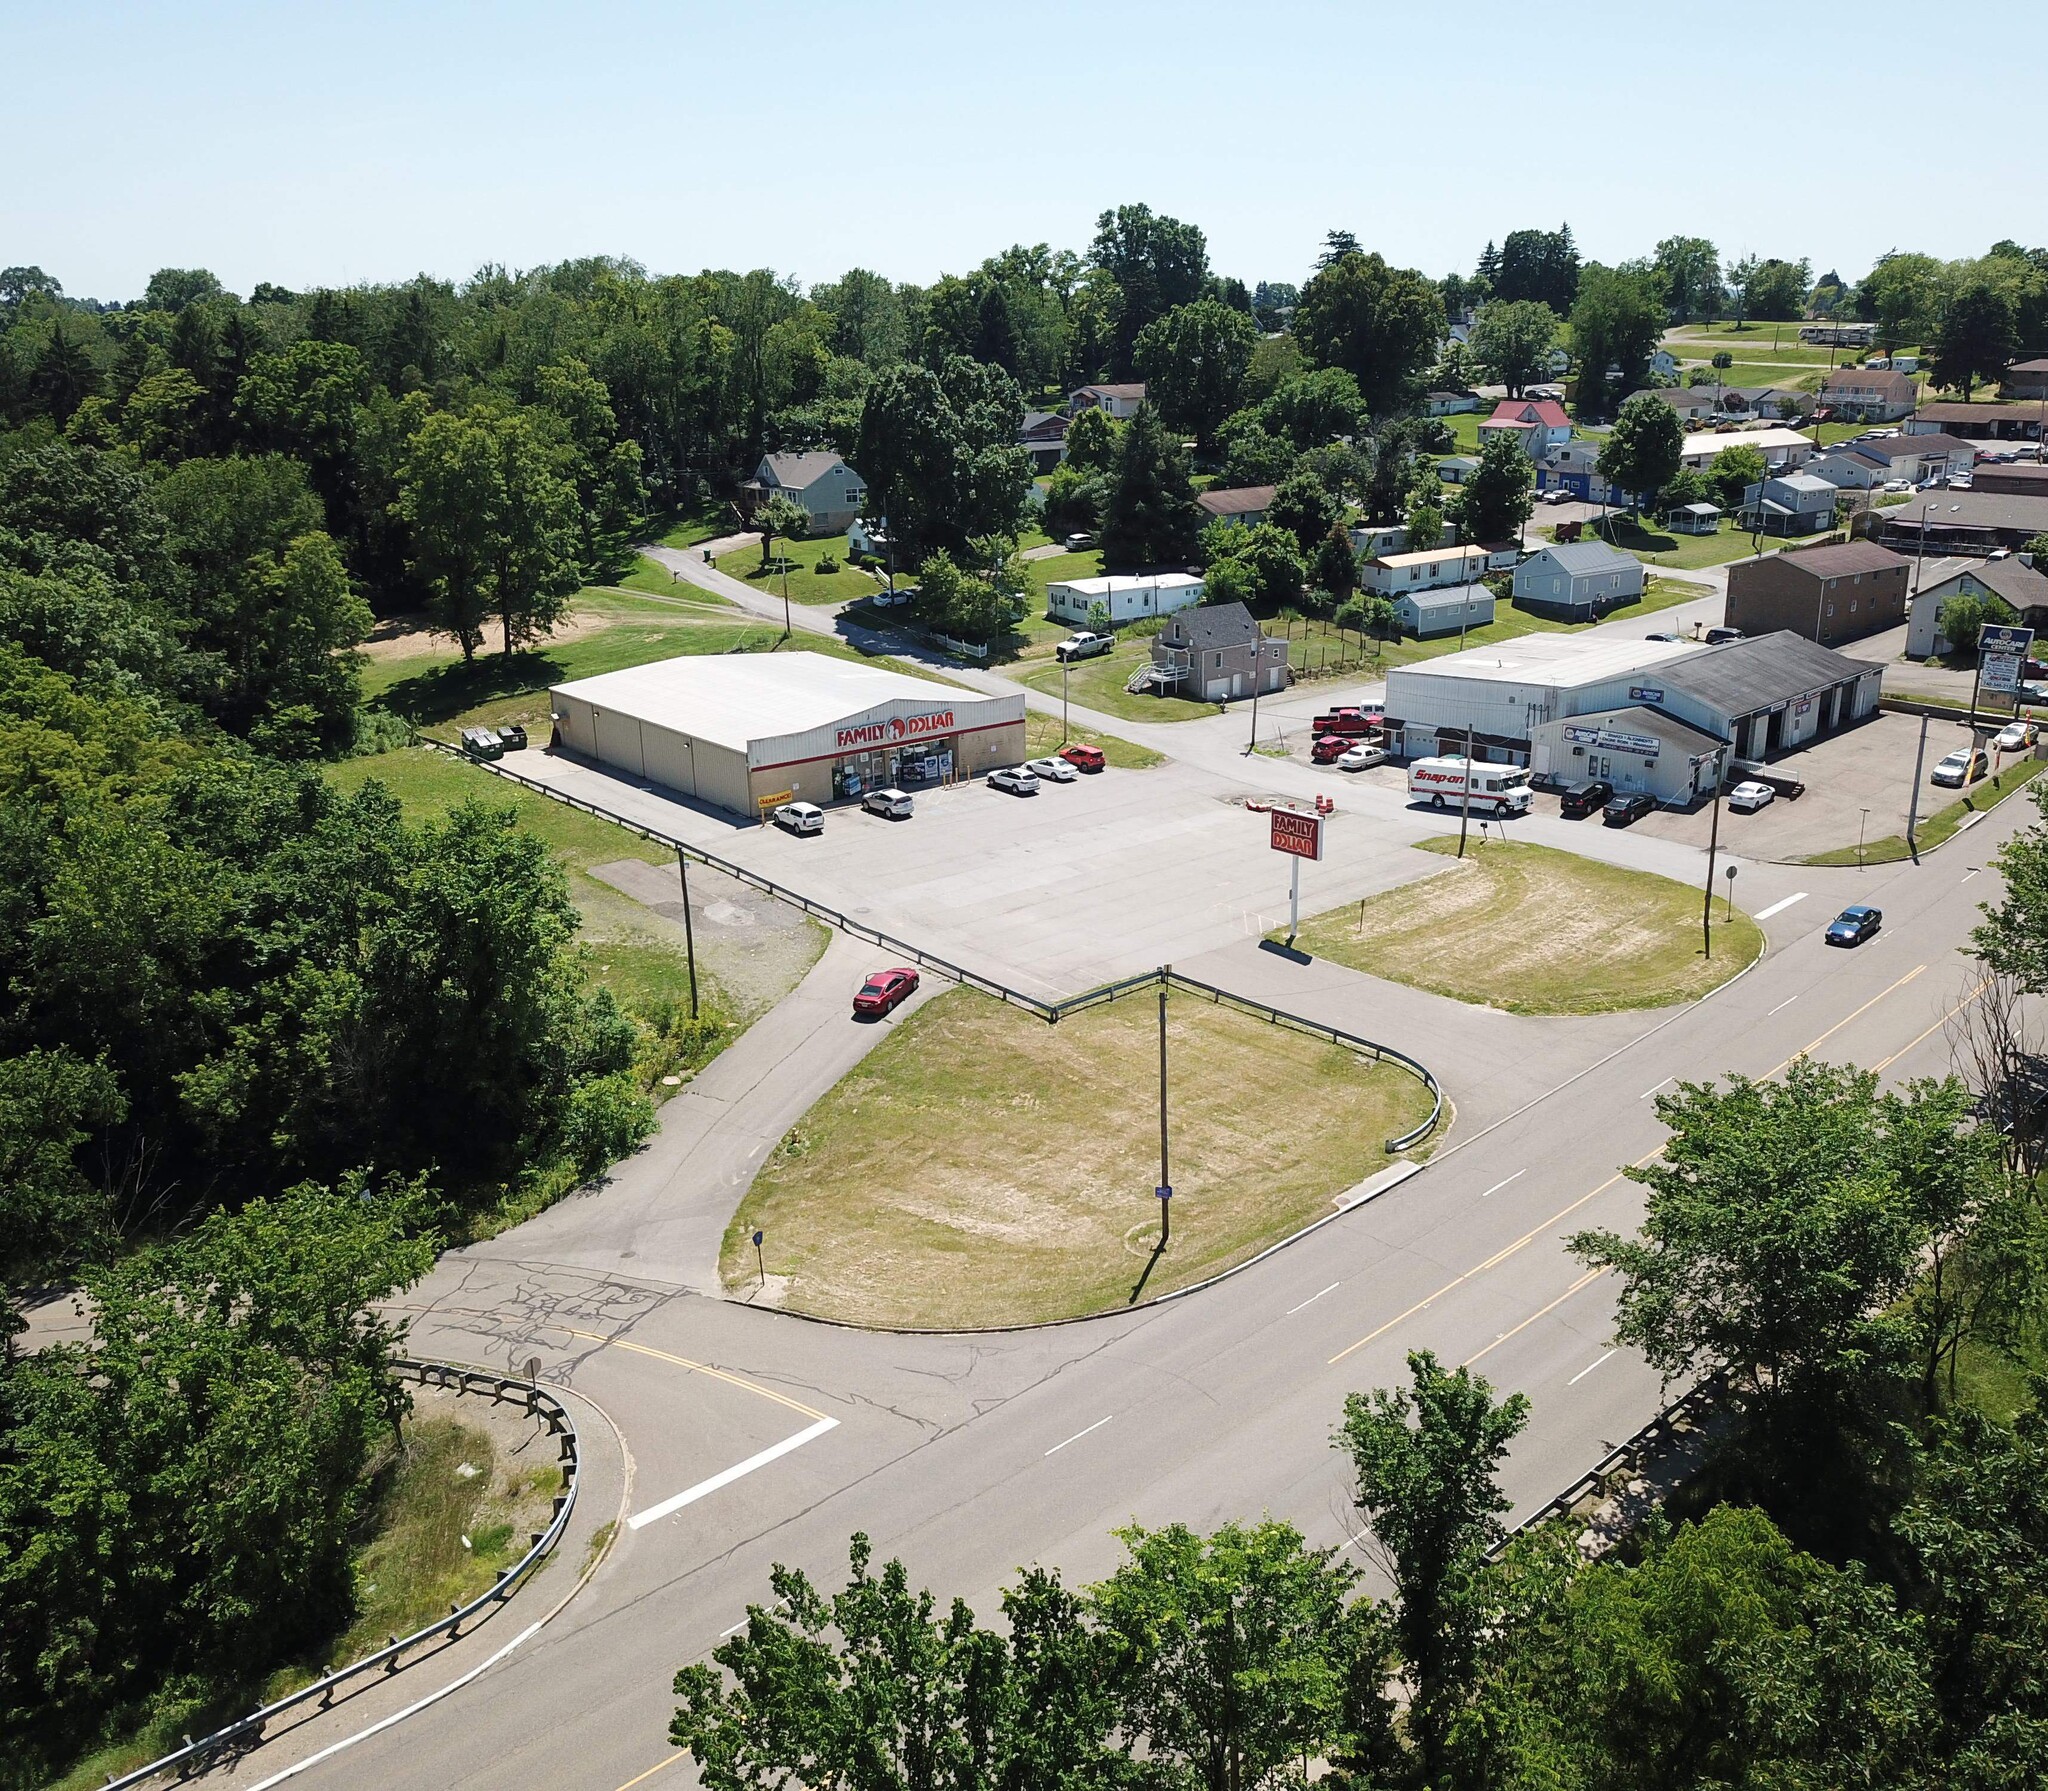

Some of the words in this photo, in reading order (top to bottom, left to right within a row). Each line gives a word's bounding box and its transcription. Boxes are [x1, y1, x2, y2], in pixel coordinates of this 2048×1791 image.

[836, 723, 886, 748] FAMILY
[908, 711, 954, 734] DOLLAR
[1414, 769, 1466, 784] Snap-on
[1273, 813, 1314, 838] FAMILY
[1273, 832, 1312, 855] DOLLAR
